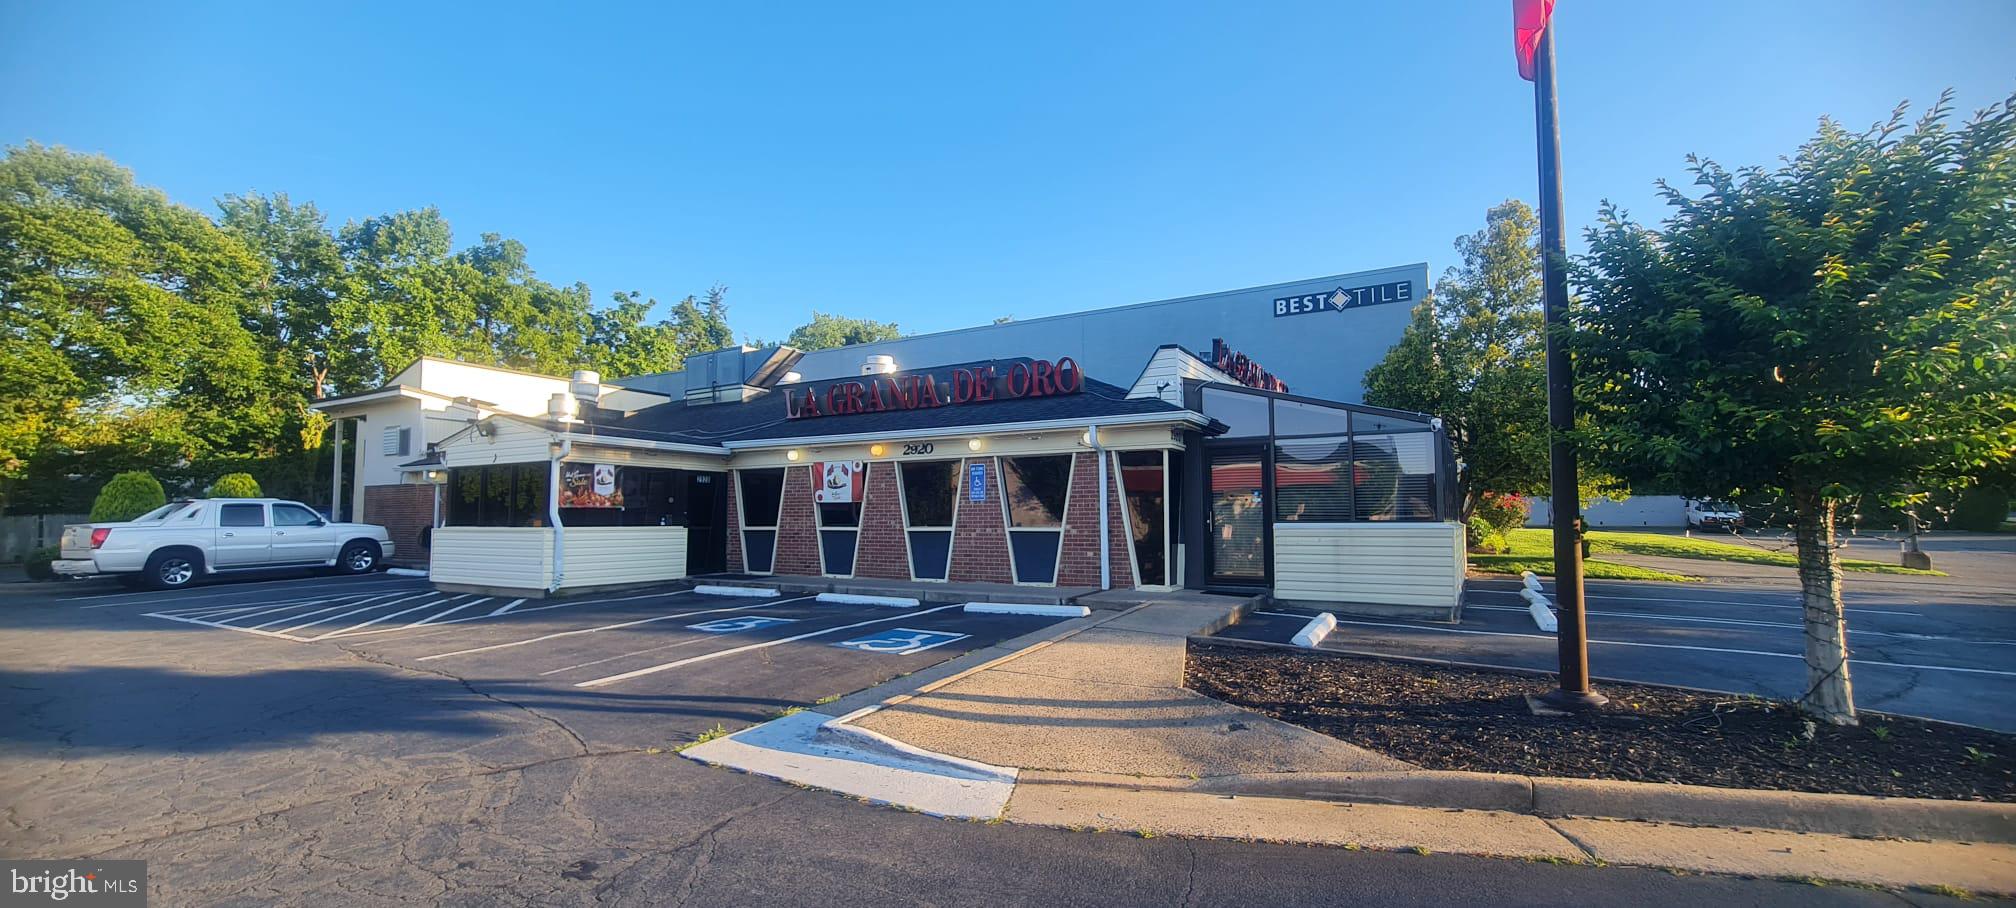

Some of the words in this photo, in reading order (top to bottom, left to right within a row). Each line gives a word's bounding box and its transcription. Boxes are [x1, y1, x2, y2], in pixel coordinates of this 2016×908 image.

[1276, 294, 1327, 315] BEST
[1353, 283, 1409, 305] TILE
[783, 386, 820, 419] LA
[826, 374, 942, 416] GRANJA
[953, 365, 994, 403] DE
[1007, 356, 1080, 397] ORO
[903, 442, 934, 456] 2920
